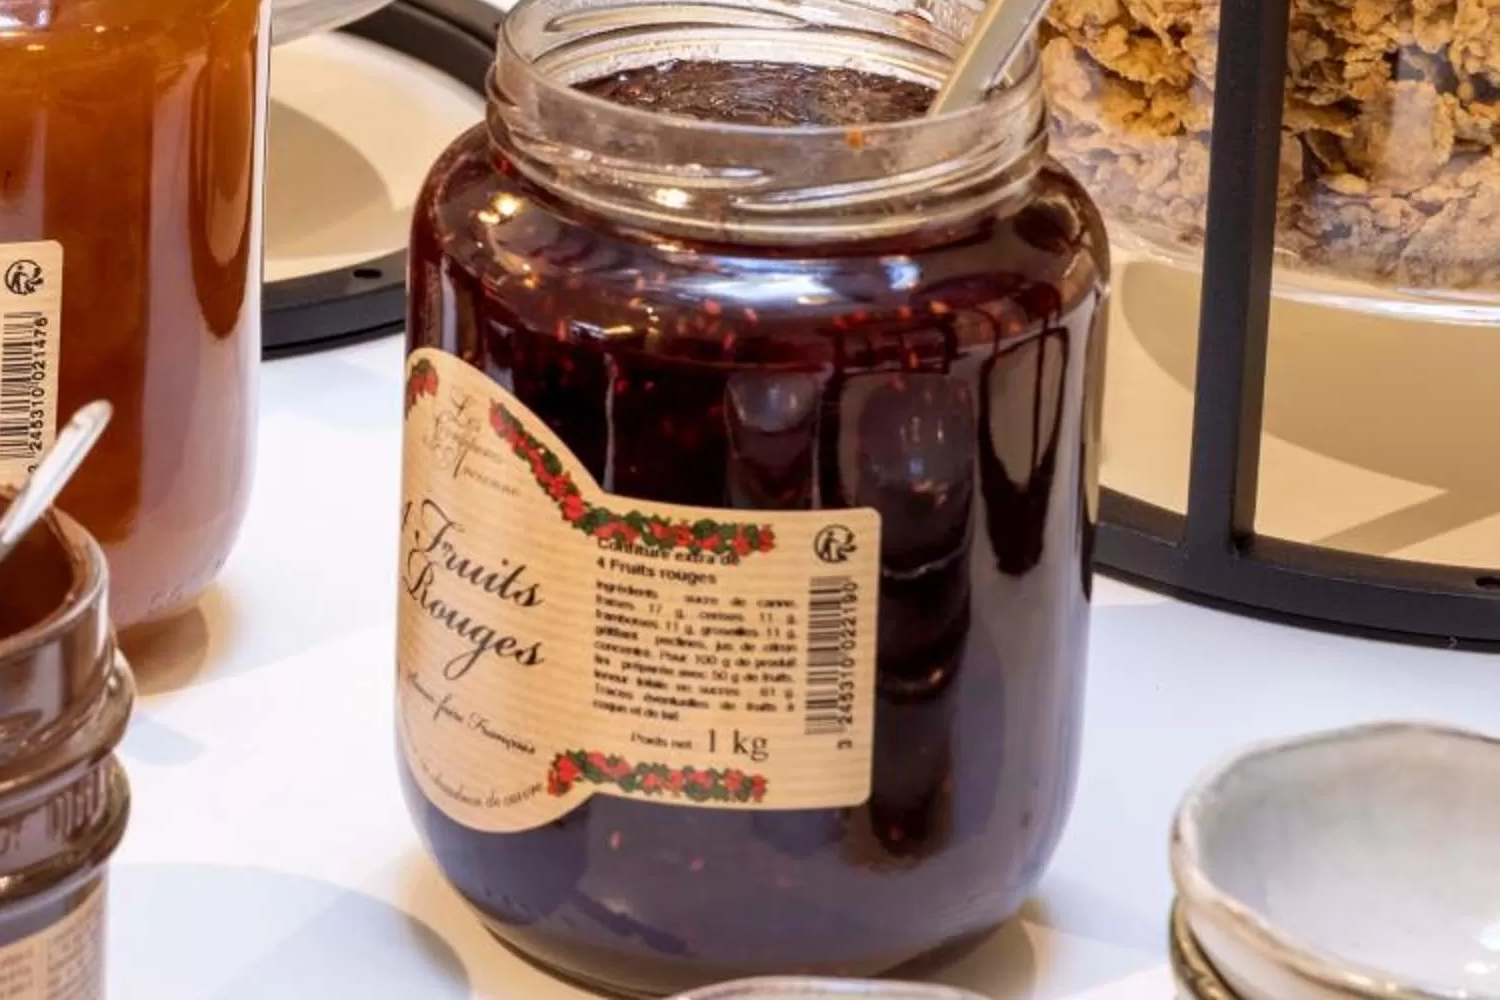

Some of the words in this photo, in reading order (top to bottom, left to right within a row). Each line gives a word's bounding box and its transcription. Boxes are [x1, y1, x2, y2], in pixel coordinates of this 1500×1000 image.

[610, 559, 655, 577] Fruits
[660, 568, 717, 585] rouges
[403, 550, 546, 680] Rouges
[708, 728, 716, 752] 1
[733, 729, 768, 762] kg
